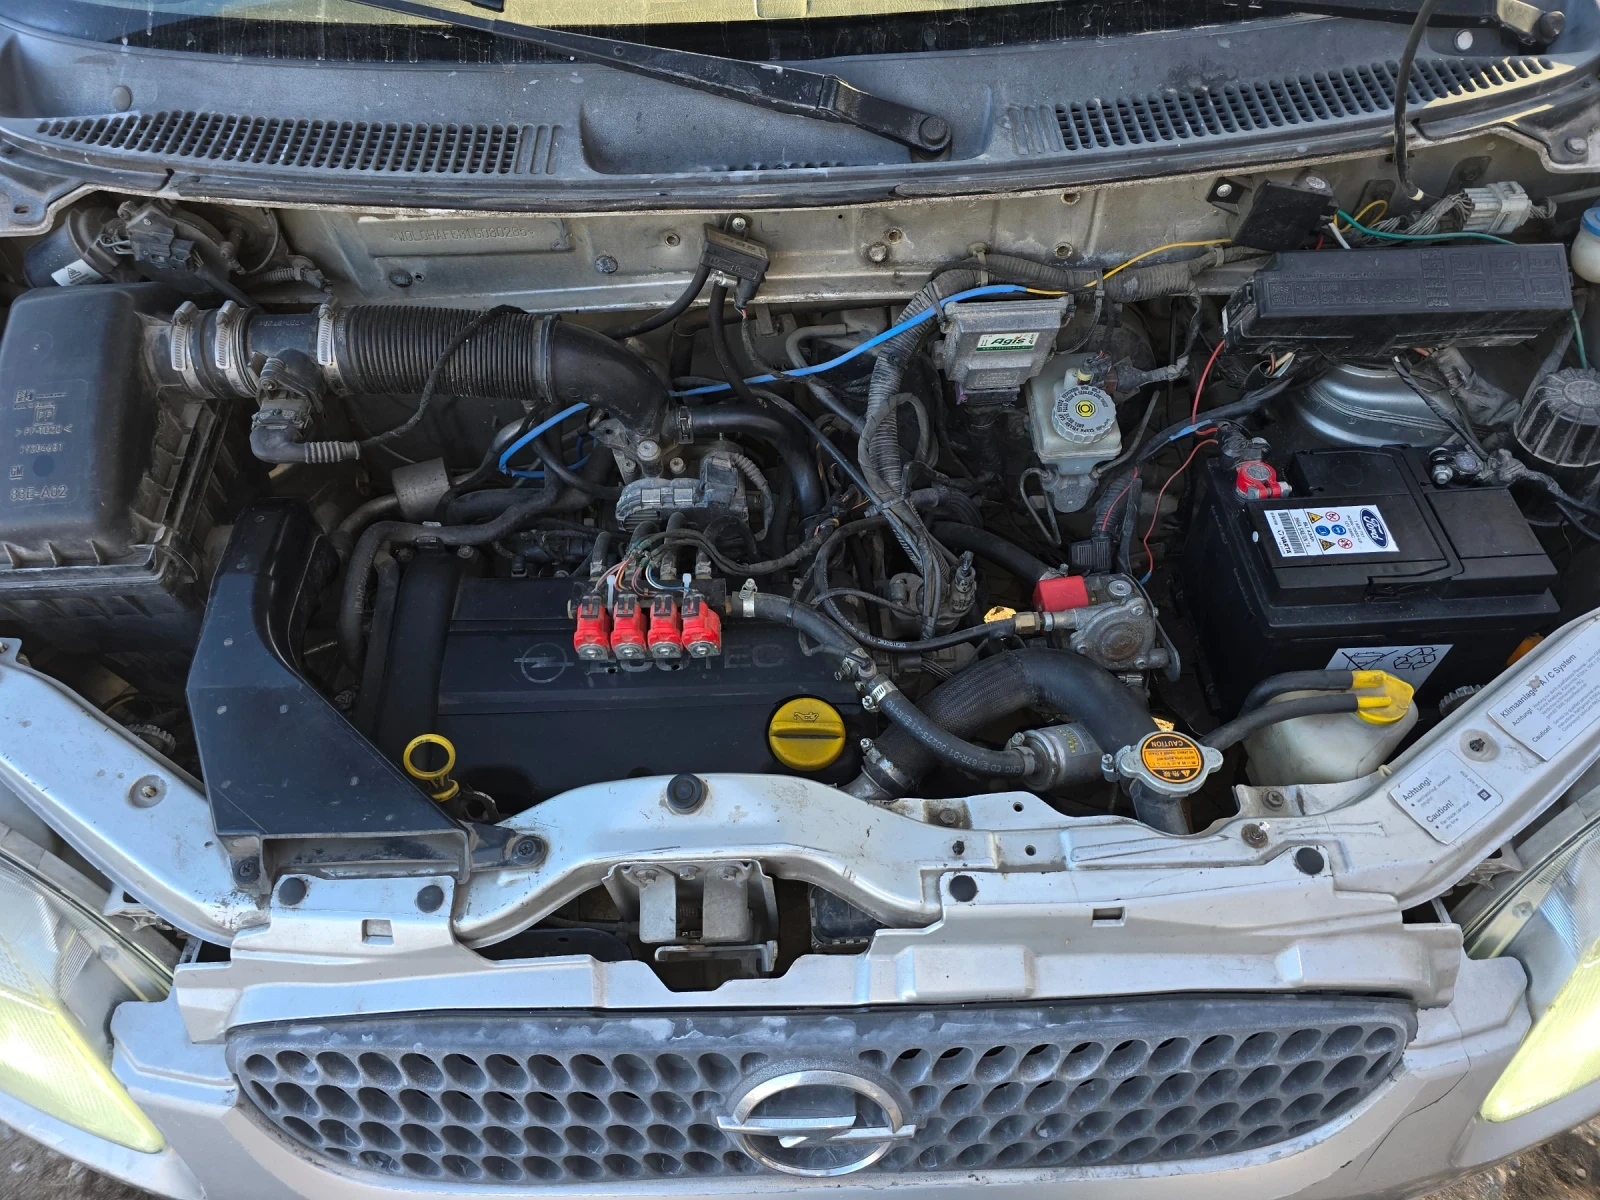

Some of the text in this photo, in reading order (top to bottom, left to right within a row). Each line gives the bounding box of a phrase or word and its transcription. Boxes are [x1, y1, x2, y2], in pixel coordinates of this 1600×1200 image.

[991, 336, 1026, 345] Agis
[10, 466, 24, 478] GM
[1280, 534, 1292, 554] VARTA
[1500, 688, 1538, 718] Klimaanlage
[1553, 654, 1577, 674] System
[886, 701, 904, 719] R110
[1512, 708, 1534, 726] Achtung!
[1532, 725, 1552, 743] Caution!
[1402, 777, 1432, 801] Achtung!
[1426, 800, 1454, 823] Caution!
